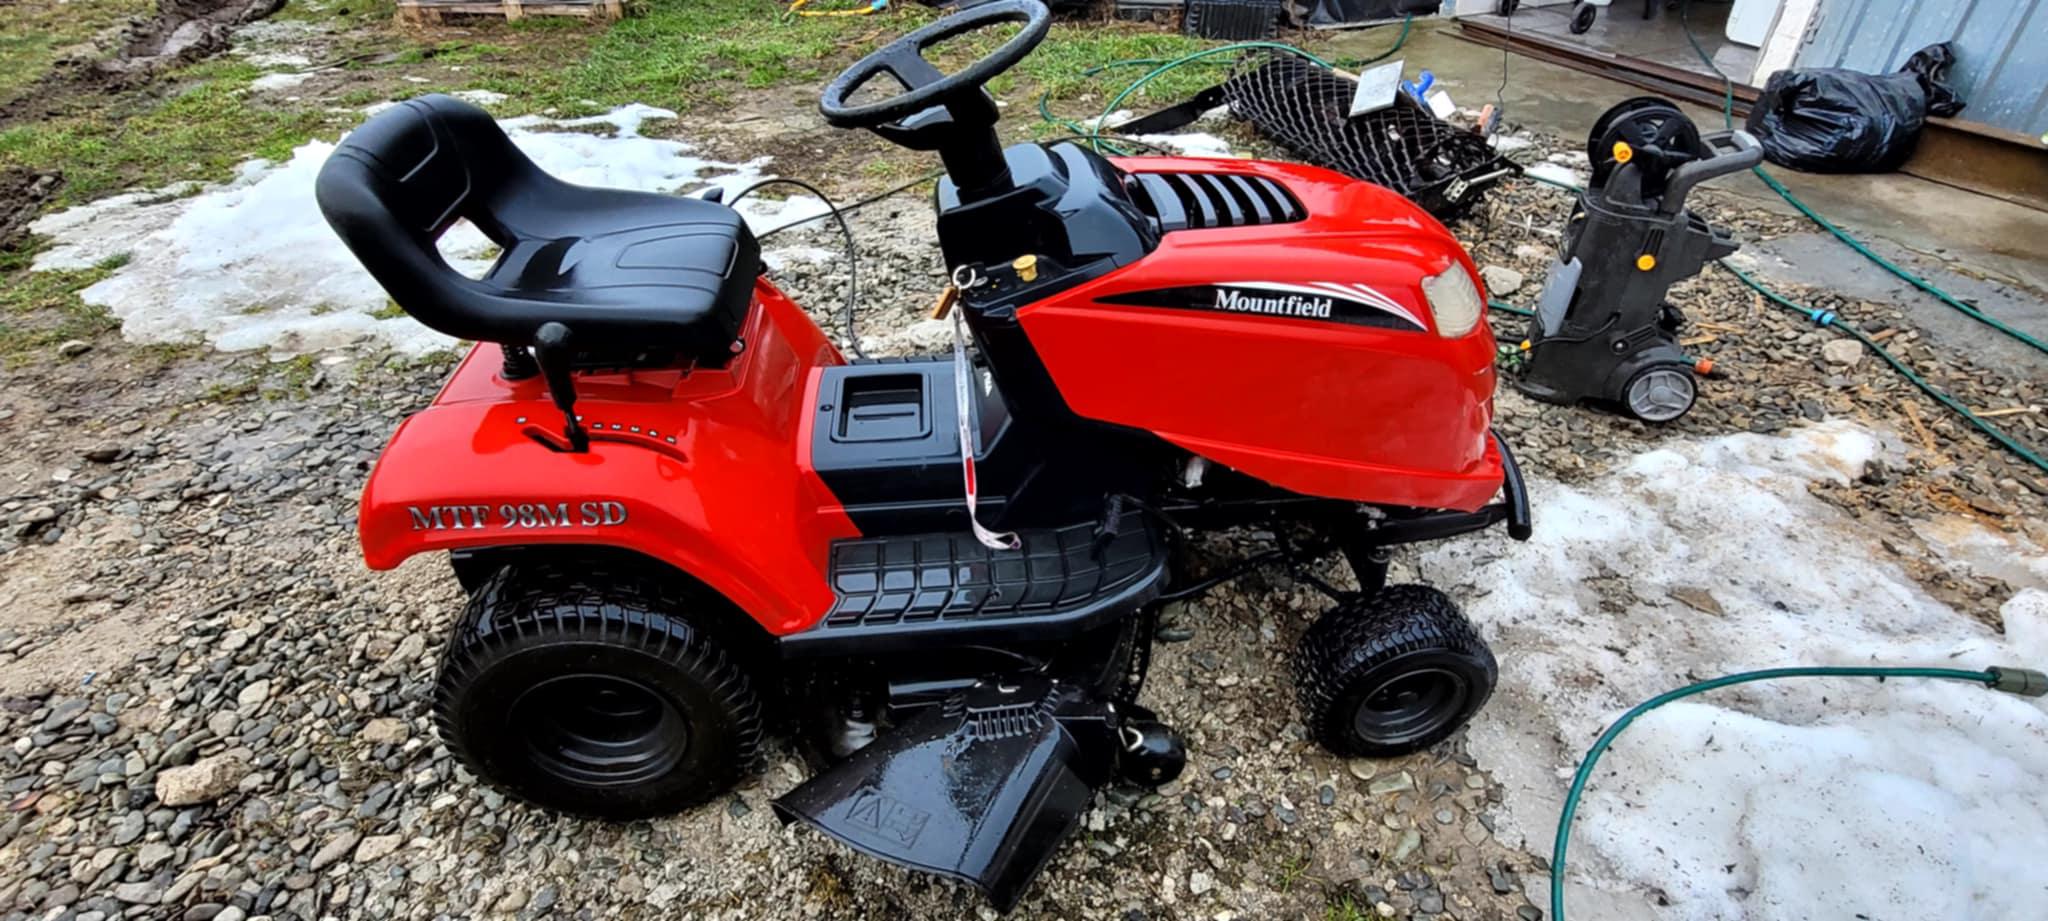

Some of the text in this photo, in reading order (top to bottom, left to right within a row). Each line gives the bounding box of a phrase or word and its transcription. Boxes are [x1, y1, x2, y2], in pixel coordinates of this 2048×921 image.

[1215, 289, 1332, 318] Mountfield
[408, 501, 629, 529] MTF 98M SD
